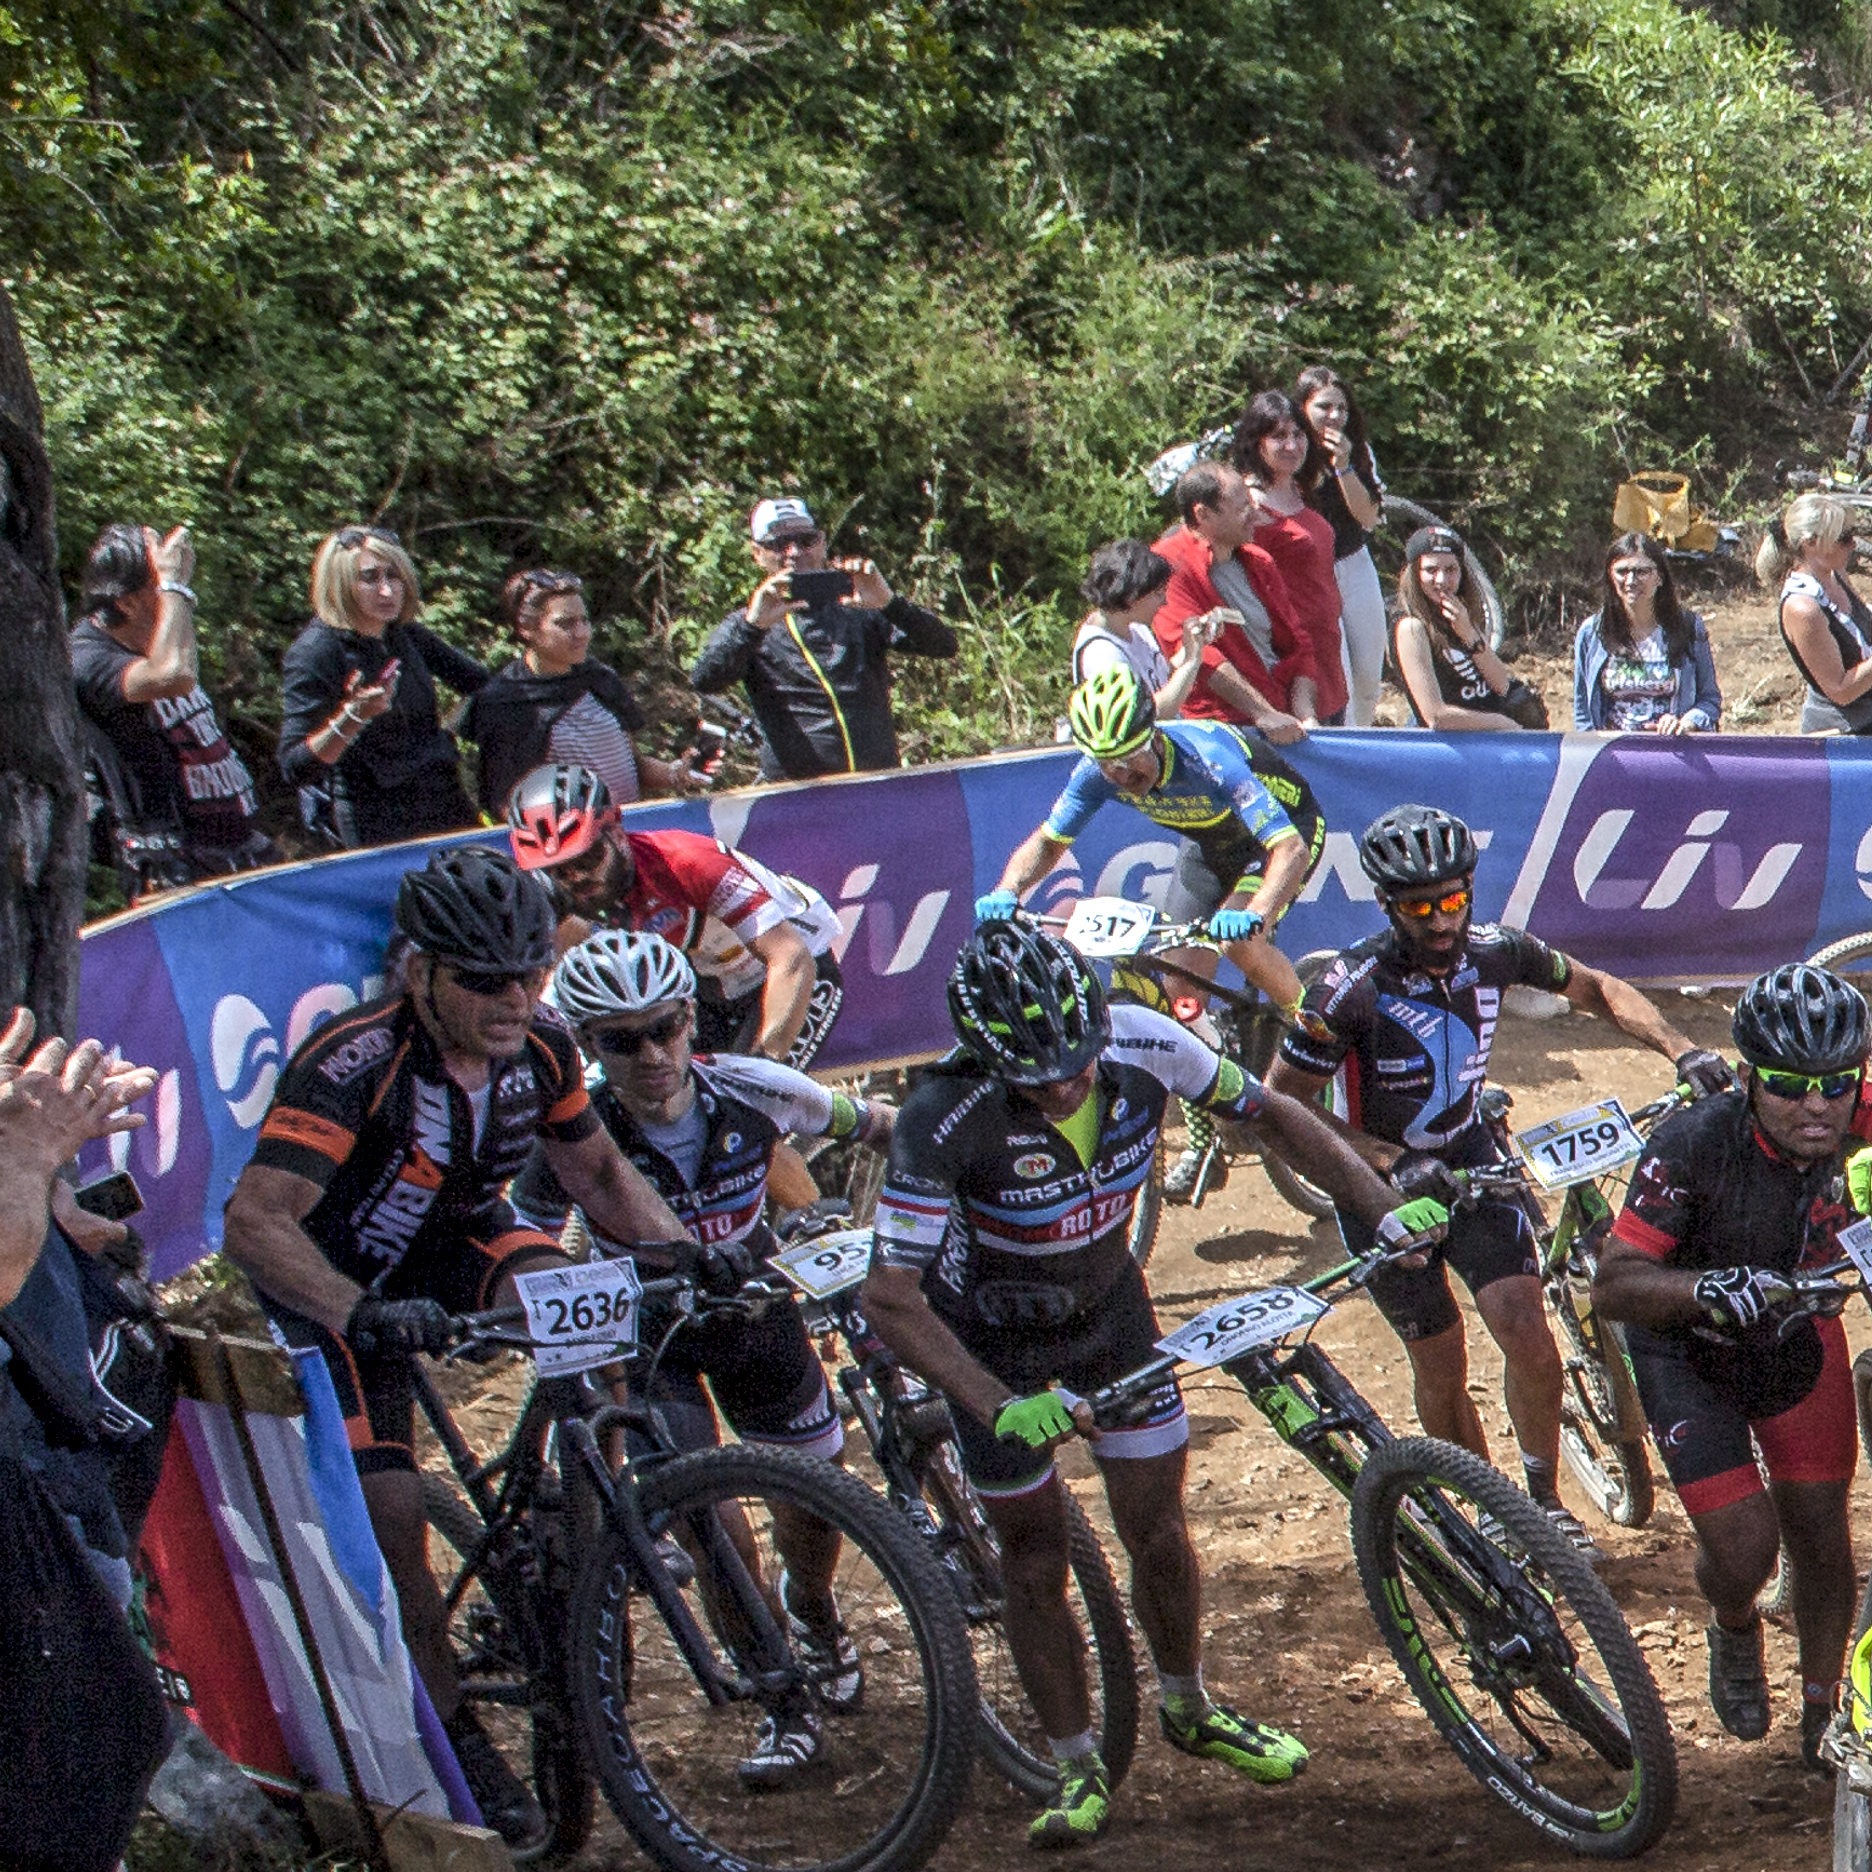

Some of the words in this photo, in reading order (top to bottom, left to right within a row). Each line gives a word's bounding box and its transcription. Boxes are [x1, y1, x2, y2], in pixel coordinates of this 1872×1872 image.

[1573, 806, 1803, 912] Liv
[1079, 914, 1136, 938] 517
[1541, 1122, 1620, 1167] 1759
[545, 1287, 630, 1336] 2636
